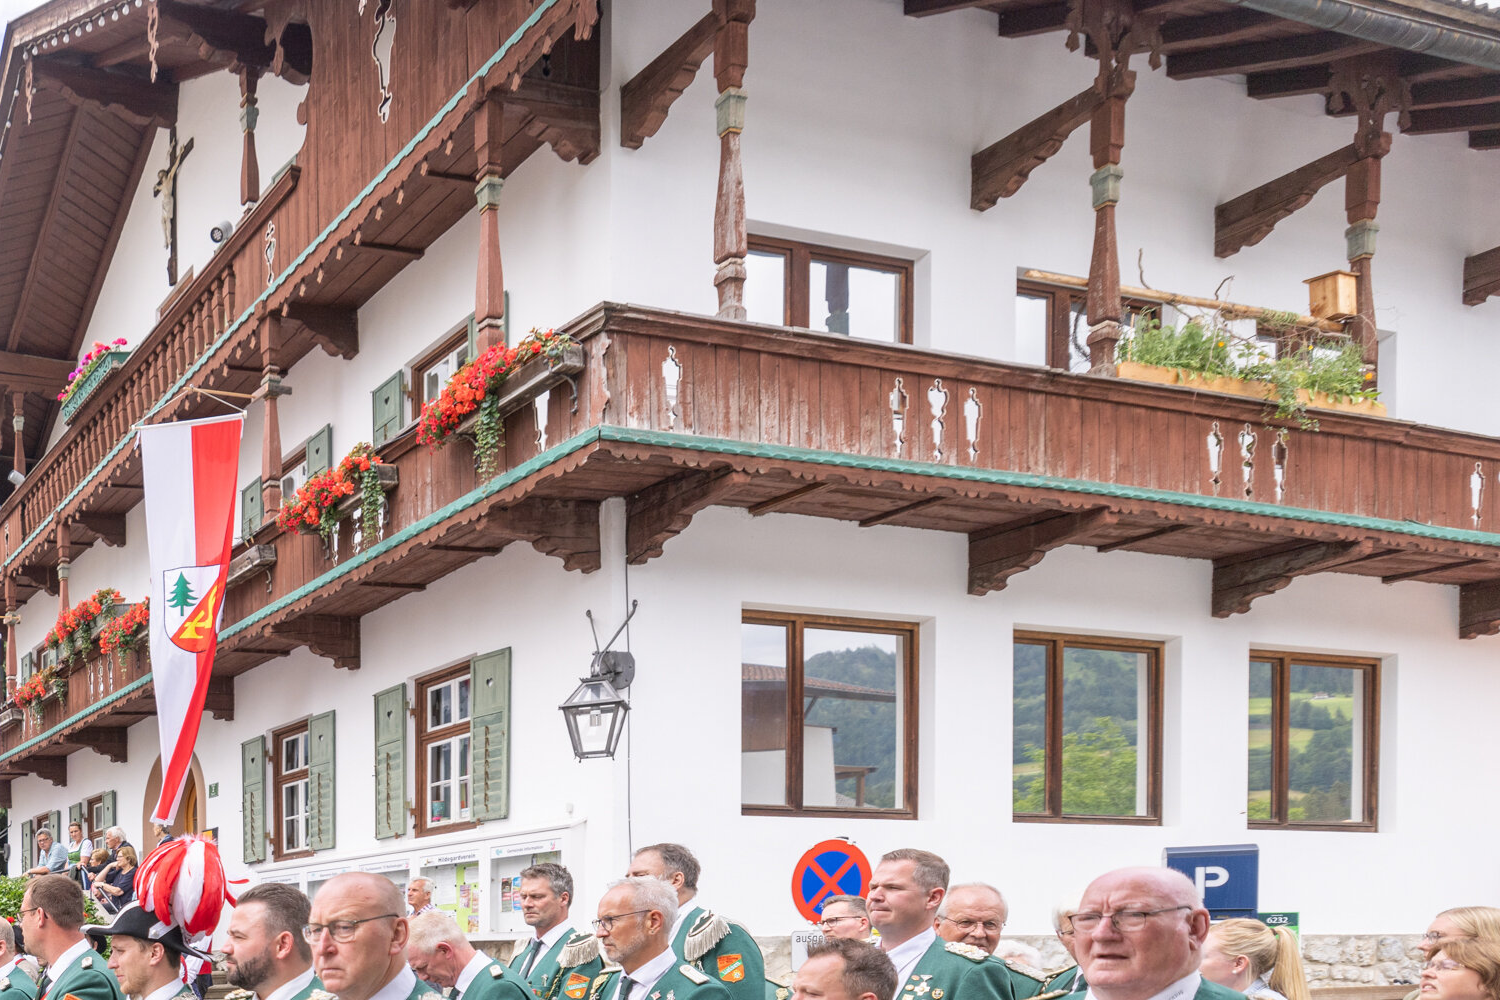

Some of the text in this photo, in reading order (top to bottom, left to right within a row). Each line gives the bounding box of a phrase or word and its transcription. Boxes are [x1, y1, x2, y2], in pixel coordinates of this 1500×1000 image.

[438, 853, 476, 864] Hildegardverein
[1195, 866, 1230, 899] P
[1266, 916, 1289, 925] 6232
[795, 934, 825, 944] ausge
